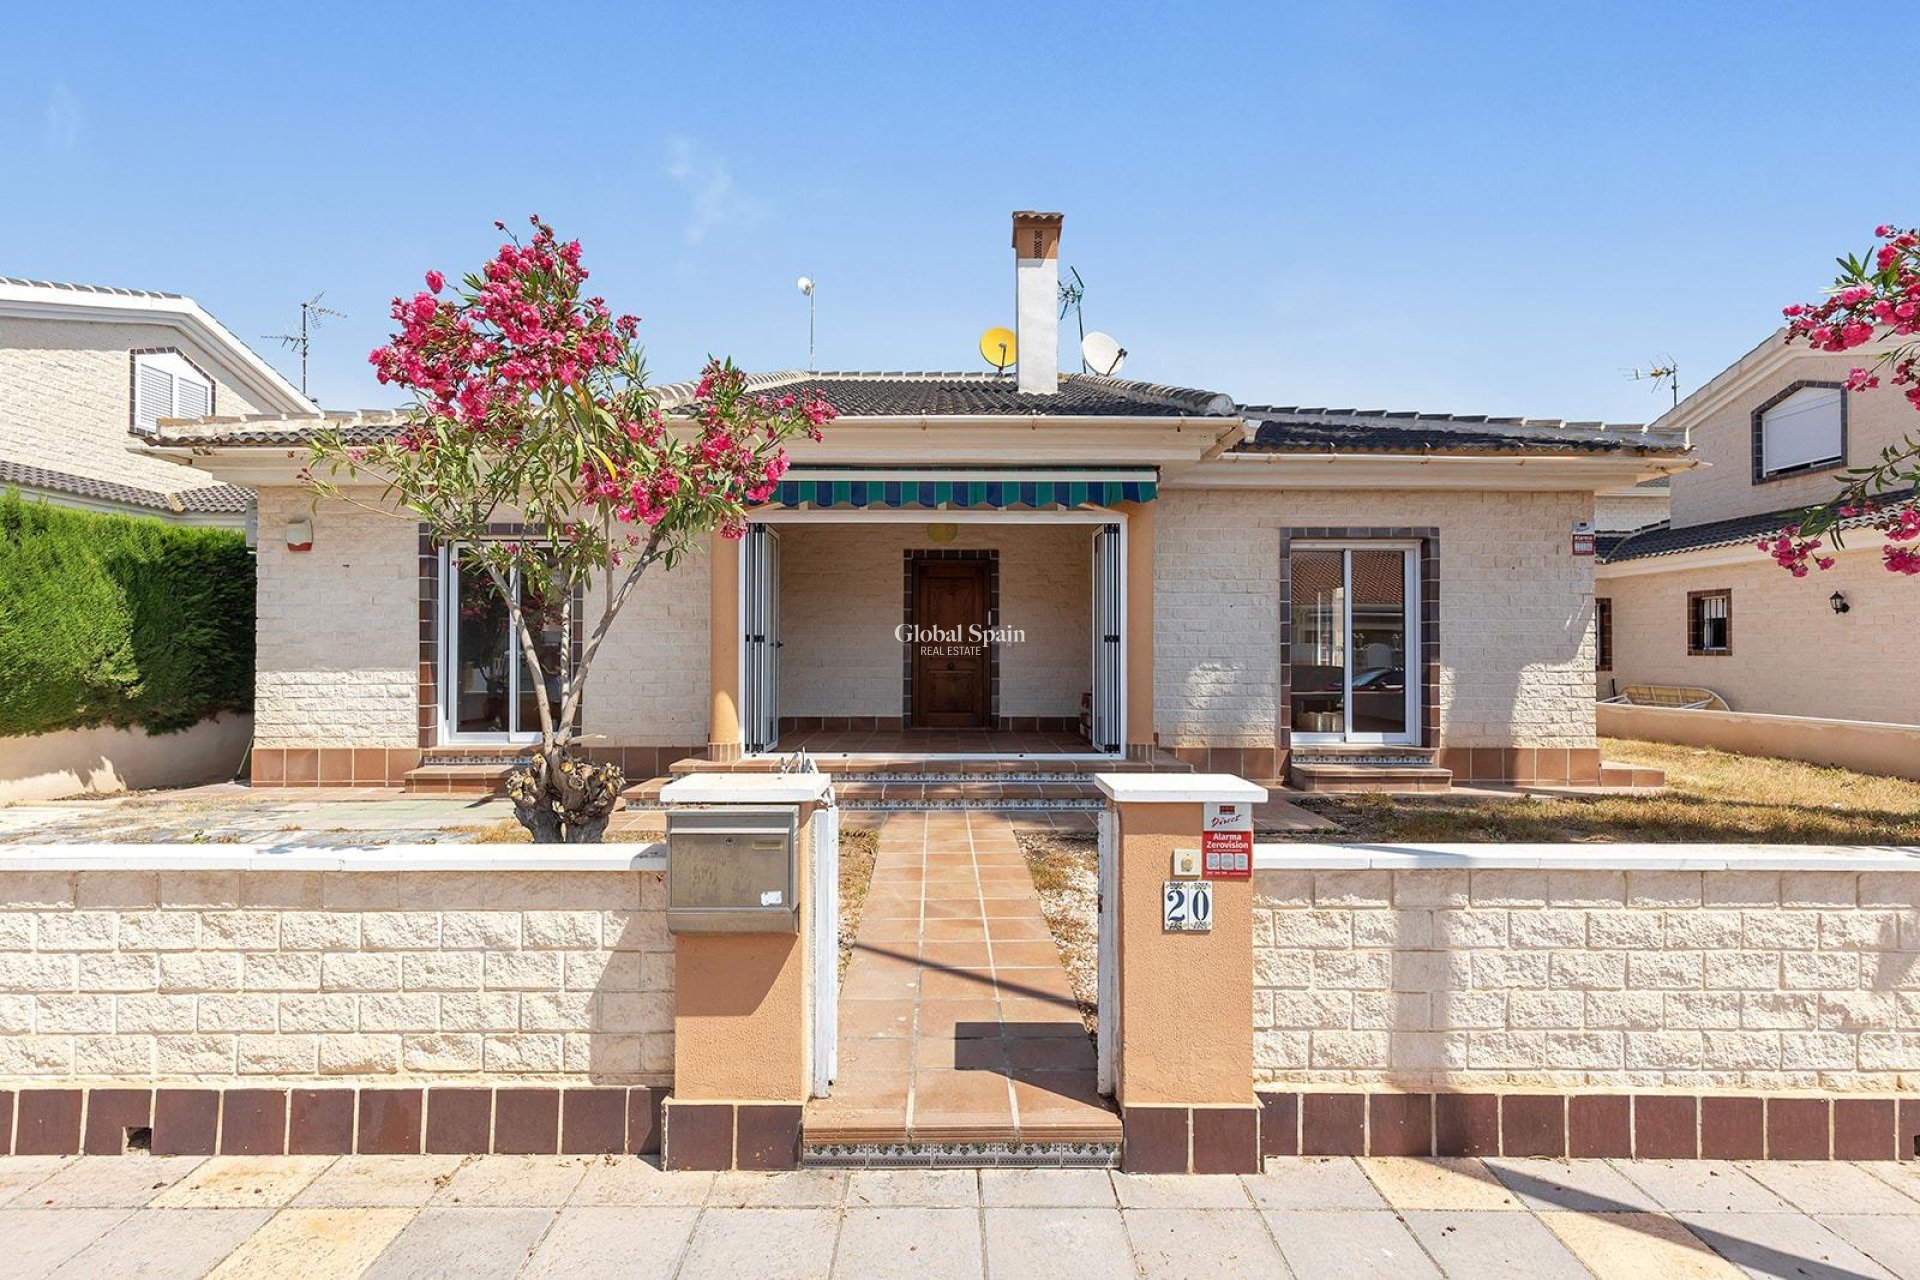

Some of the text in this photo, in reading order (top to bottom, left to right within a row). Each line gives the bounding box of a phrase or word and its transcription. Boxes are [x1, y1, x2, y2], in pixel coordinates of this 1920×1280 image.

[1213, 833, 1242, 841] Alarma
[1206, 840, 1249, 849] Zerovision
[1167, 889, 1210, 921] 20
